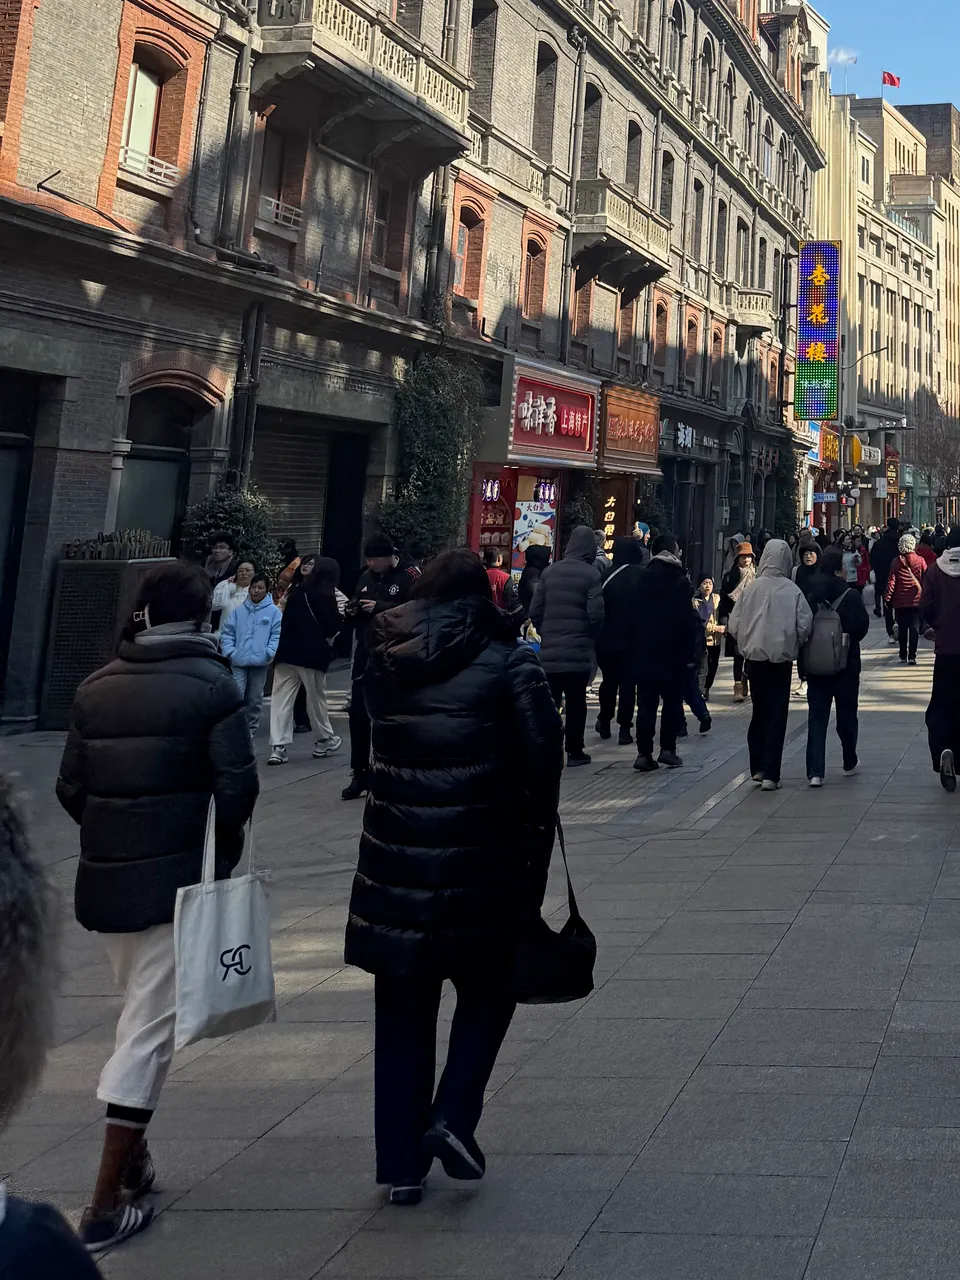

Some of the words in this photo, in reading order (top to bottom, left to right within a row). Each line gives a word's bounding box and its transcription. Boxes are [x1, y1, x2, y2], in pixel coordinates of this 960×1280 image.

[806, 263, 831, 363] 杏花楼
[561, 409, 588, 433] 上海特产
